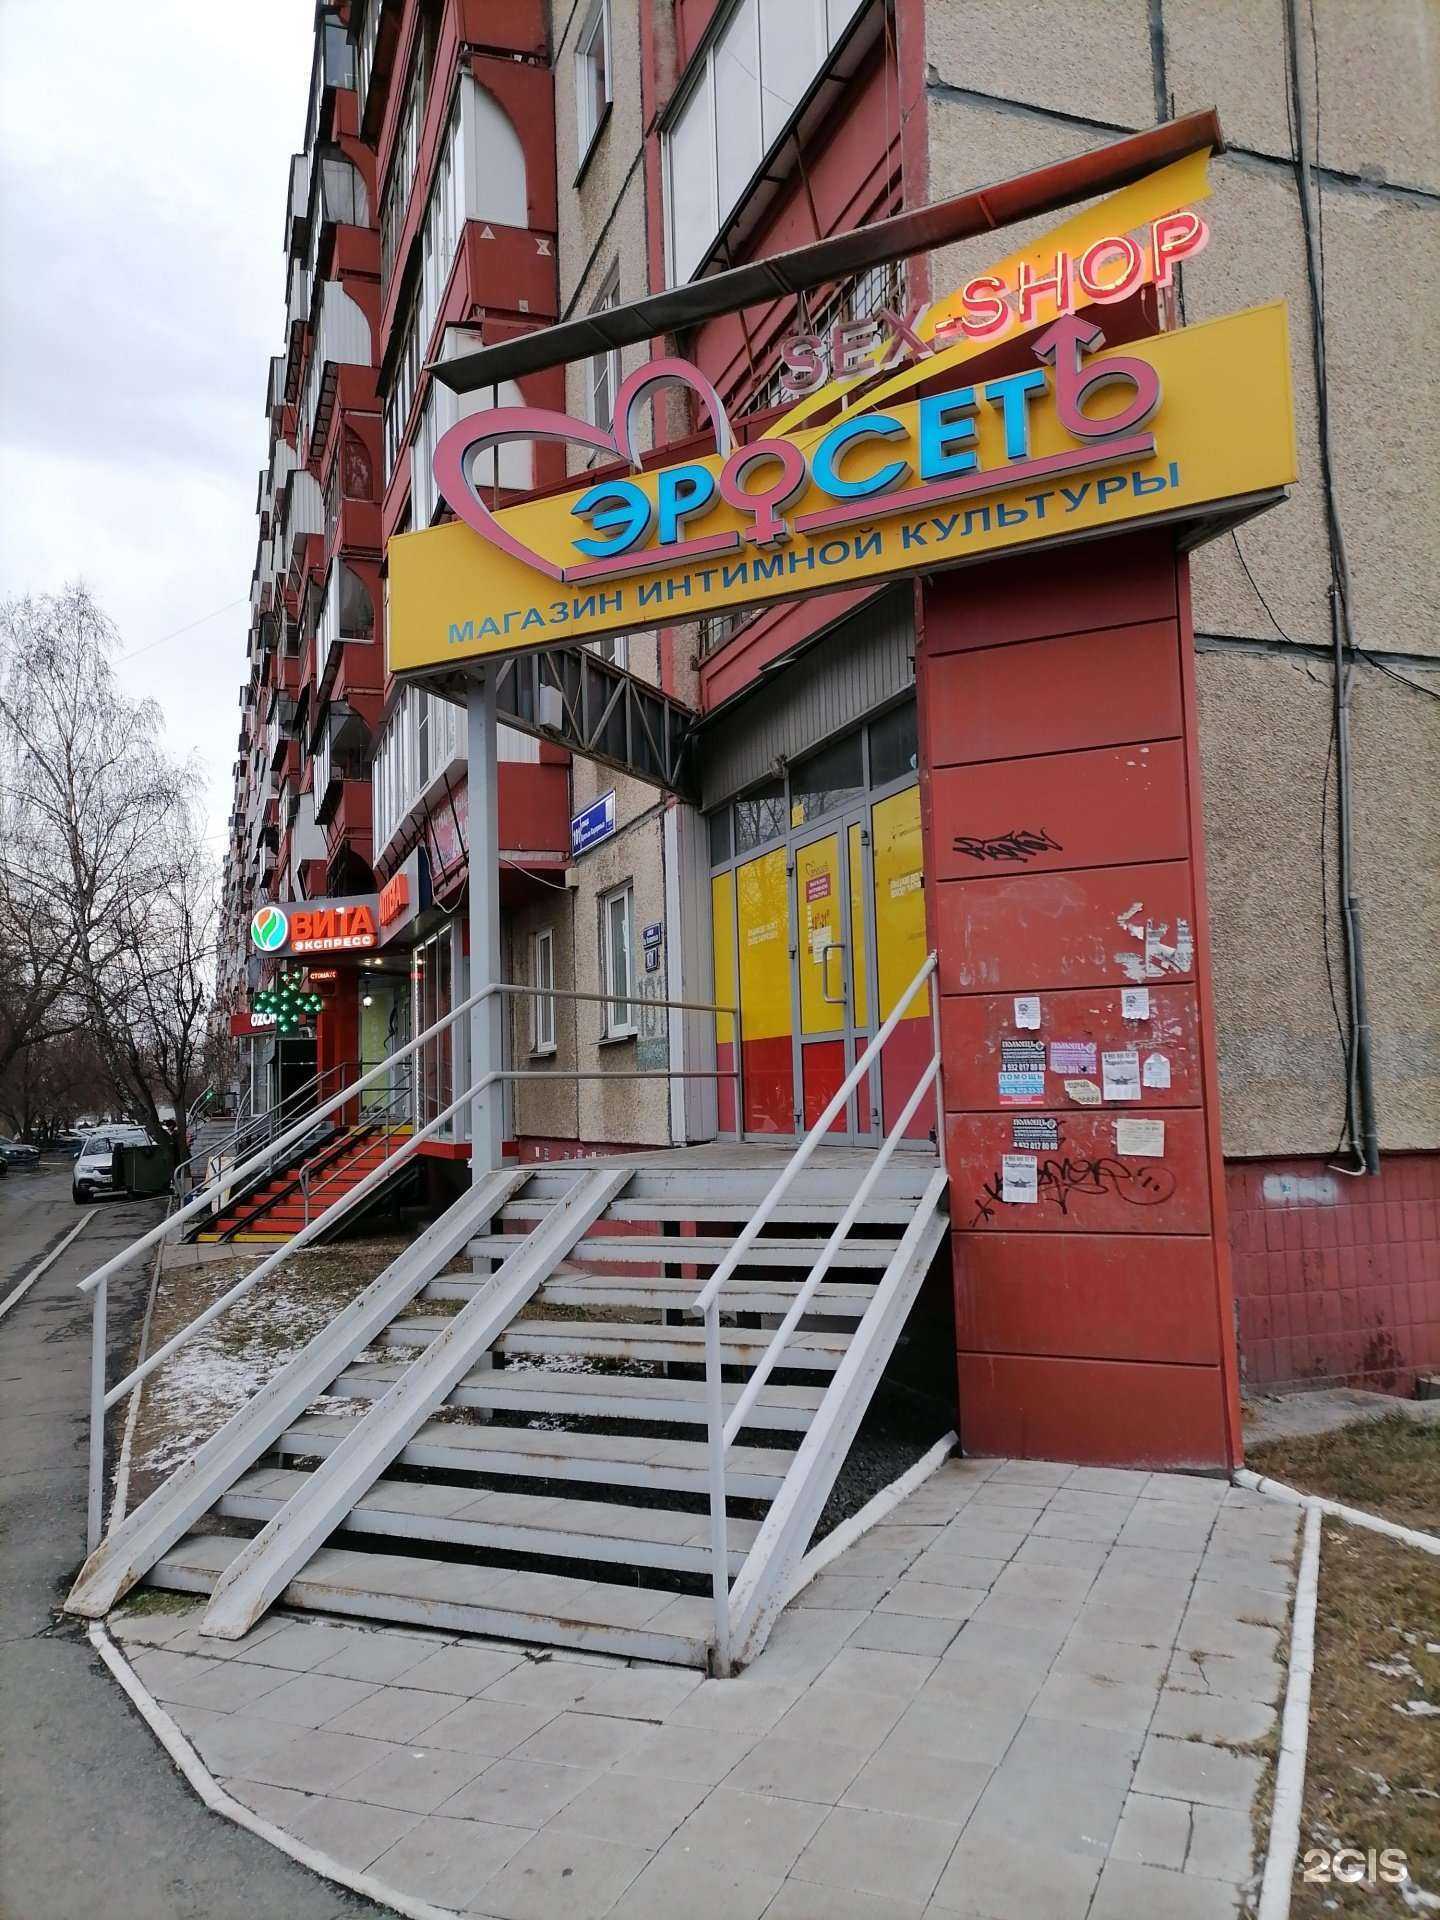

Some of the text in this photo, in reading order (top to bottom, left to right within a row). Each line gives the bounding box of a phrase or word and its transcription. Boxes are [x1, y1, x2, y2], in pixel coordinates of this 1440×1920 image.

[780, 210, 1209, 396] SEX-SHOP
[571, 314, 1161, 559] ЭРОСЕТЬ
[447, 461, 1181, 645] МАГАЗИН ИНТИМНОЙ КУЛЬТУРЫ
[290, 905, 376, 941] ВИТА
[295, 935, 373, 951] ЭКСПРЕСС
[1000, 1073, 1043, 1081] ПОМОЩЬ
